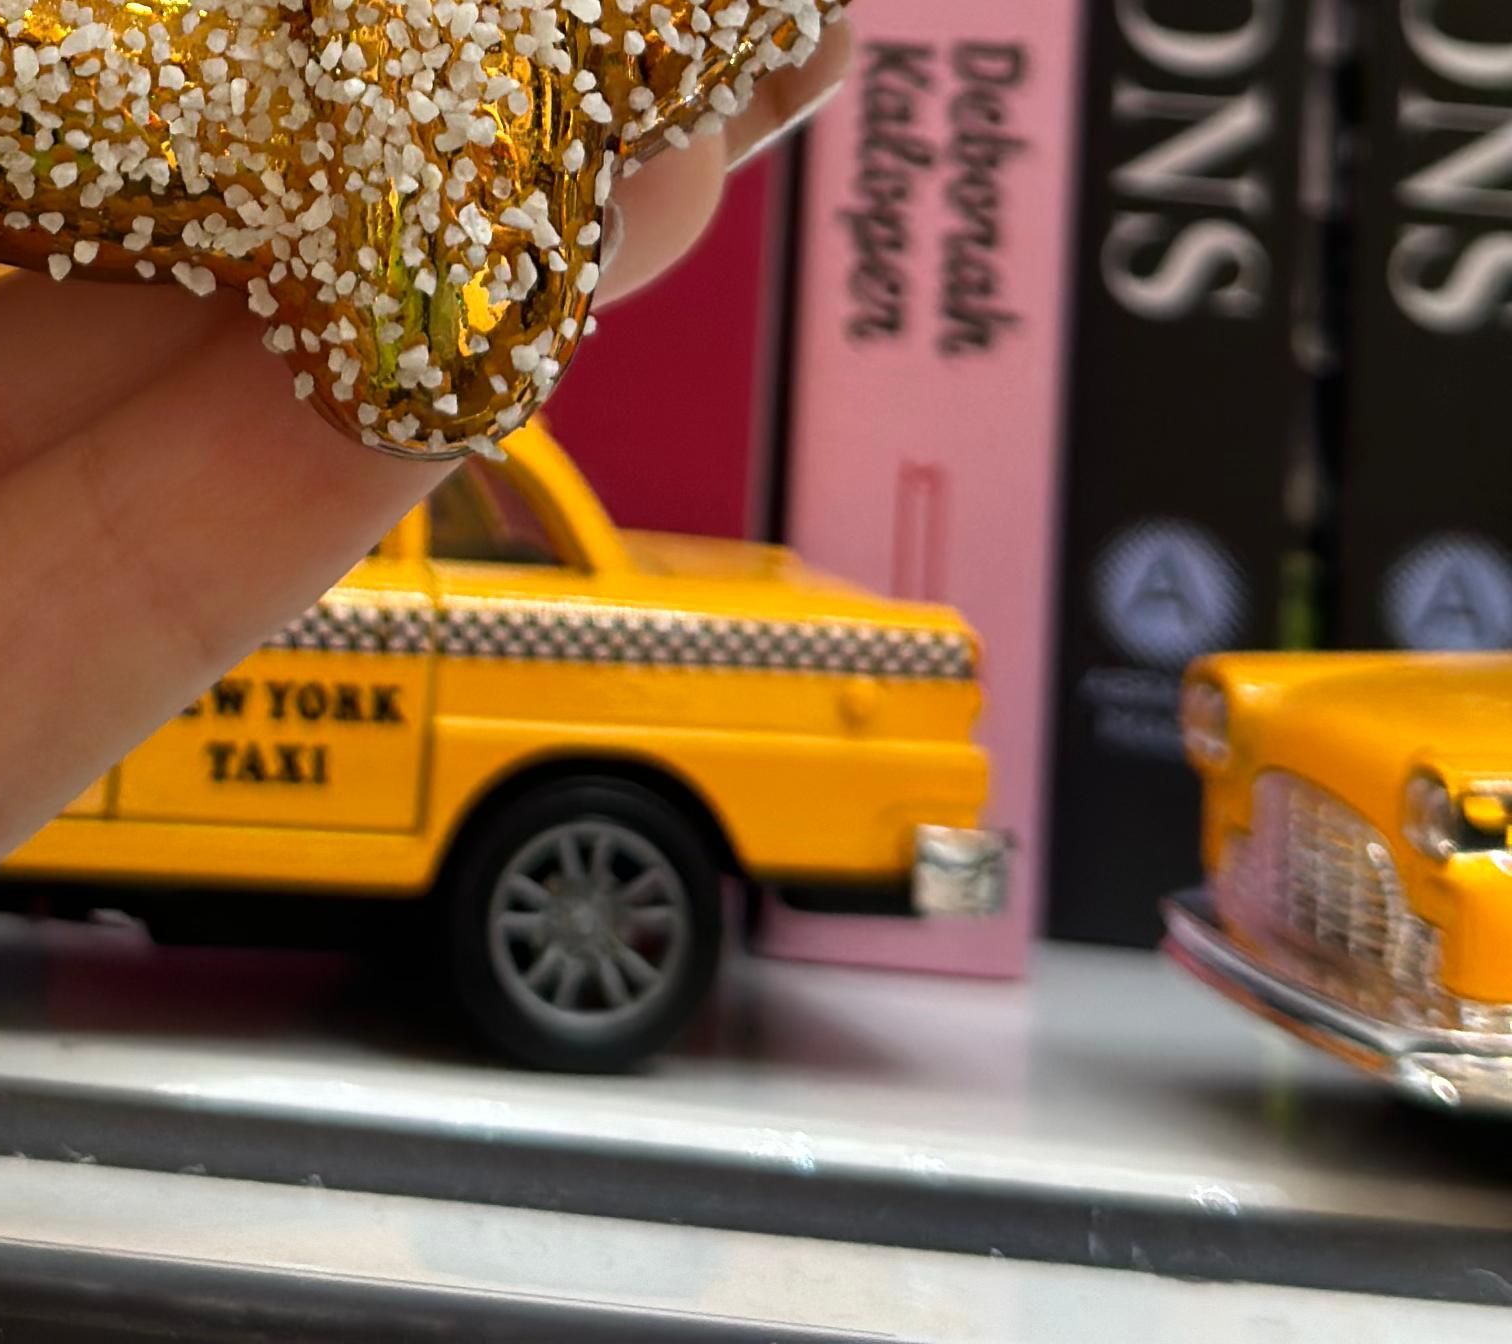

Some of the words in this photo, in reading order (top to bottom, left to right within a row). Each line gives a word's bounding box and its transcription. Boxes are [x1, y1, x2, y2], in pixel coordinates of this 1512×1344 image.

[838, 40, 943, 343] Kaloper
[938, 40, 1031, 357] Deborah
[206, 740, 328, 784] TAXI
[265, 680, 405, 723] YORK
